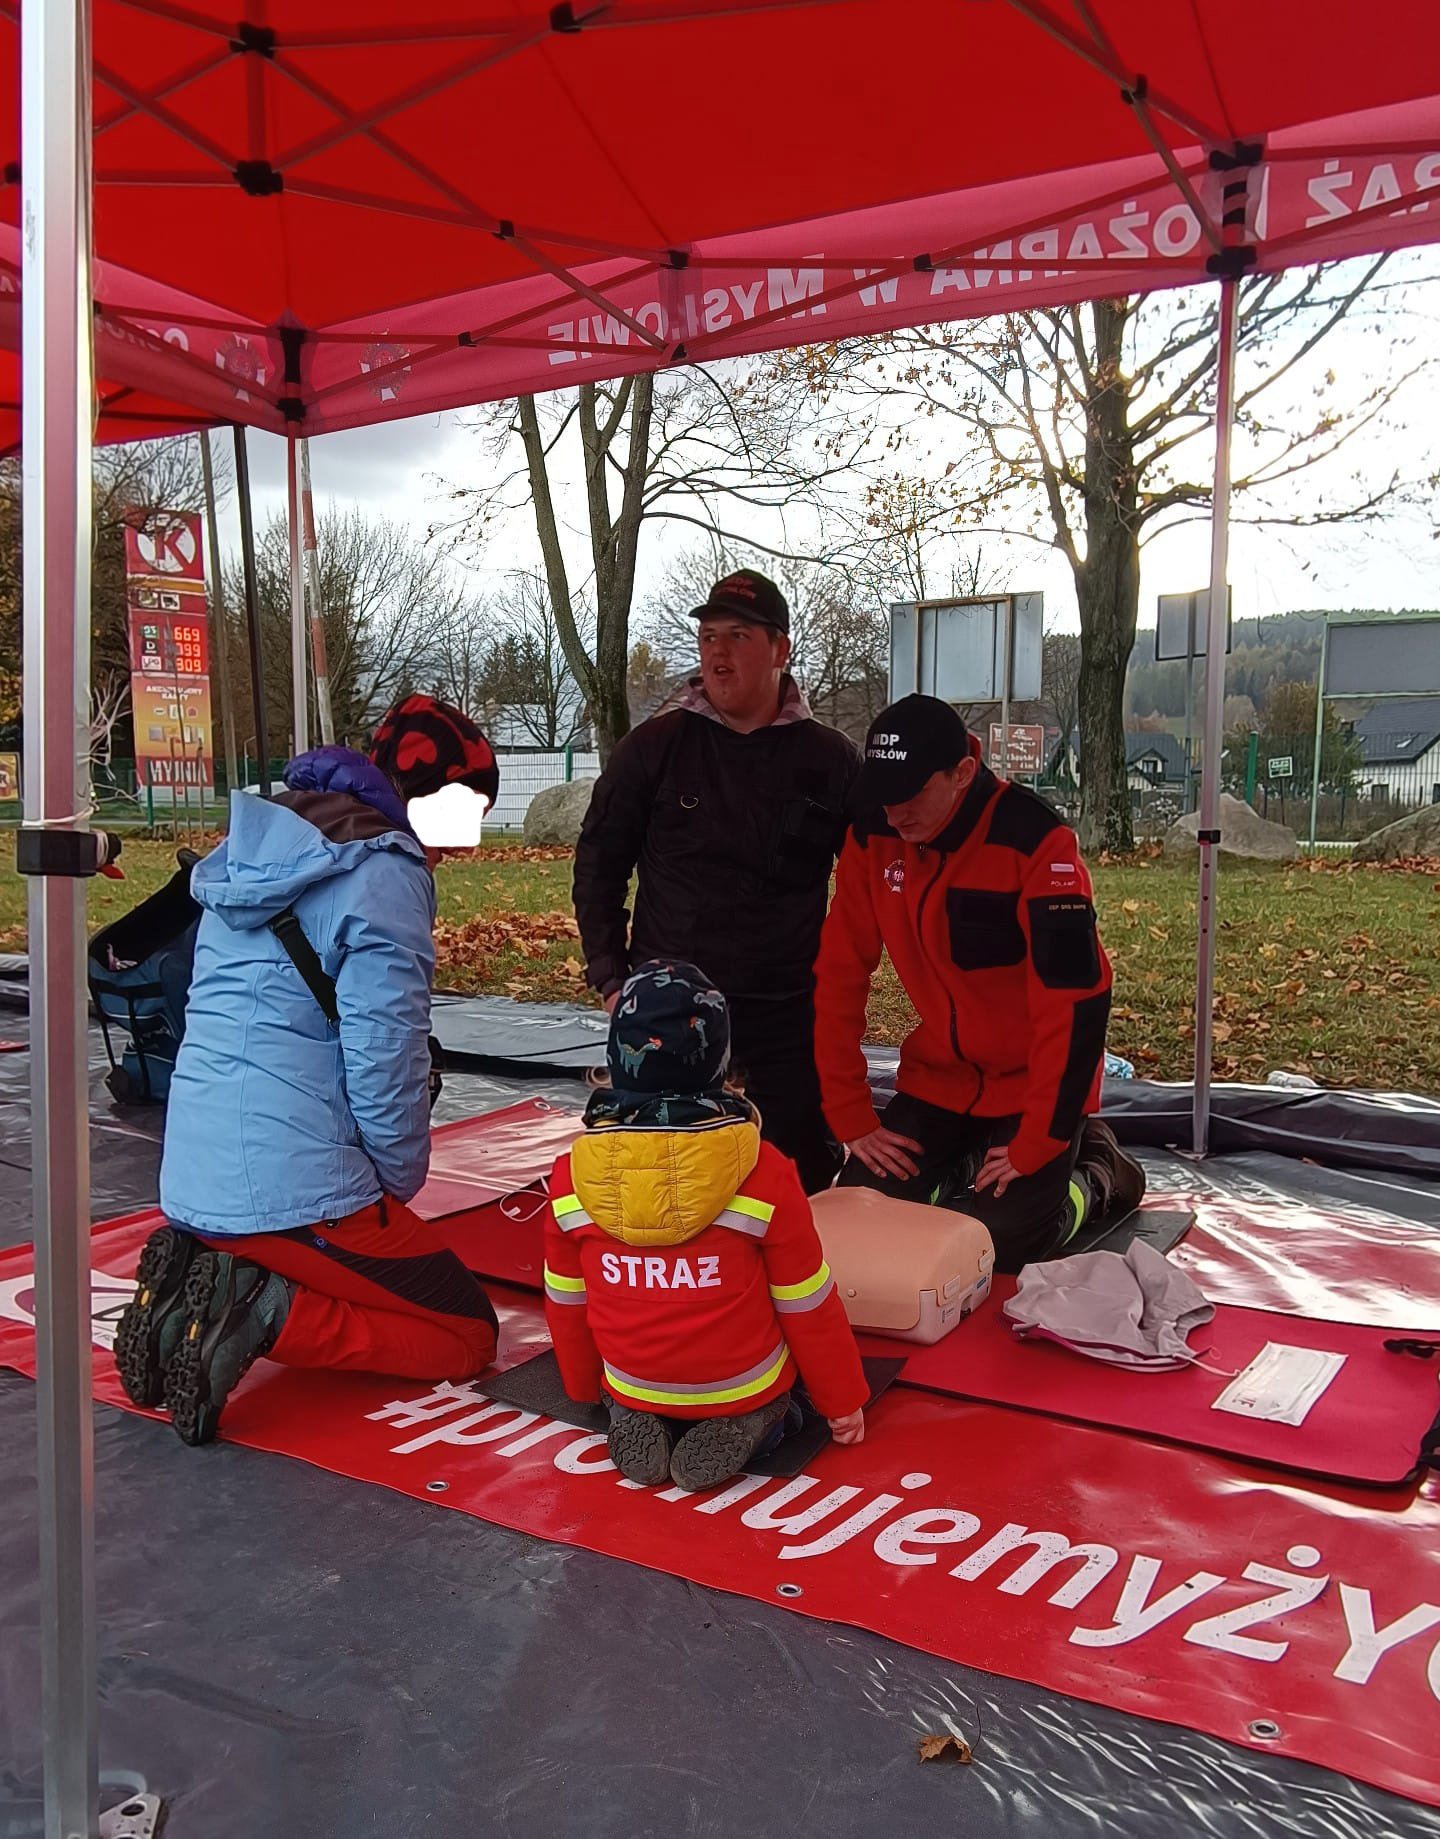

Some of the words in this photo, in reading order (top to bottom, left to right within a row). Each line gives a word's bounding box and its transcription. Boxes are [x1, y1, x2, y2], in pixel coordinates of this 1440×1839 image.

[174, 626, 200, 642] 669
[176, 657, 202, 673] 309
[364, 1379, 1440, 1704] #proujemyŻY
